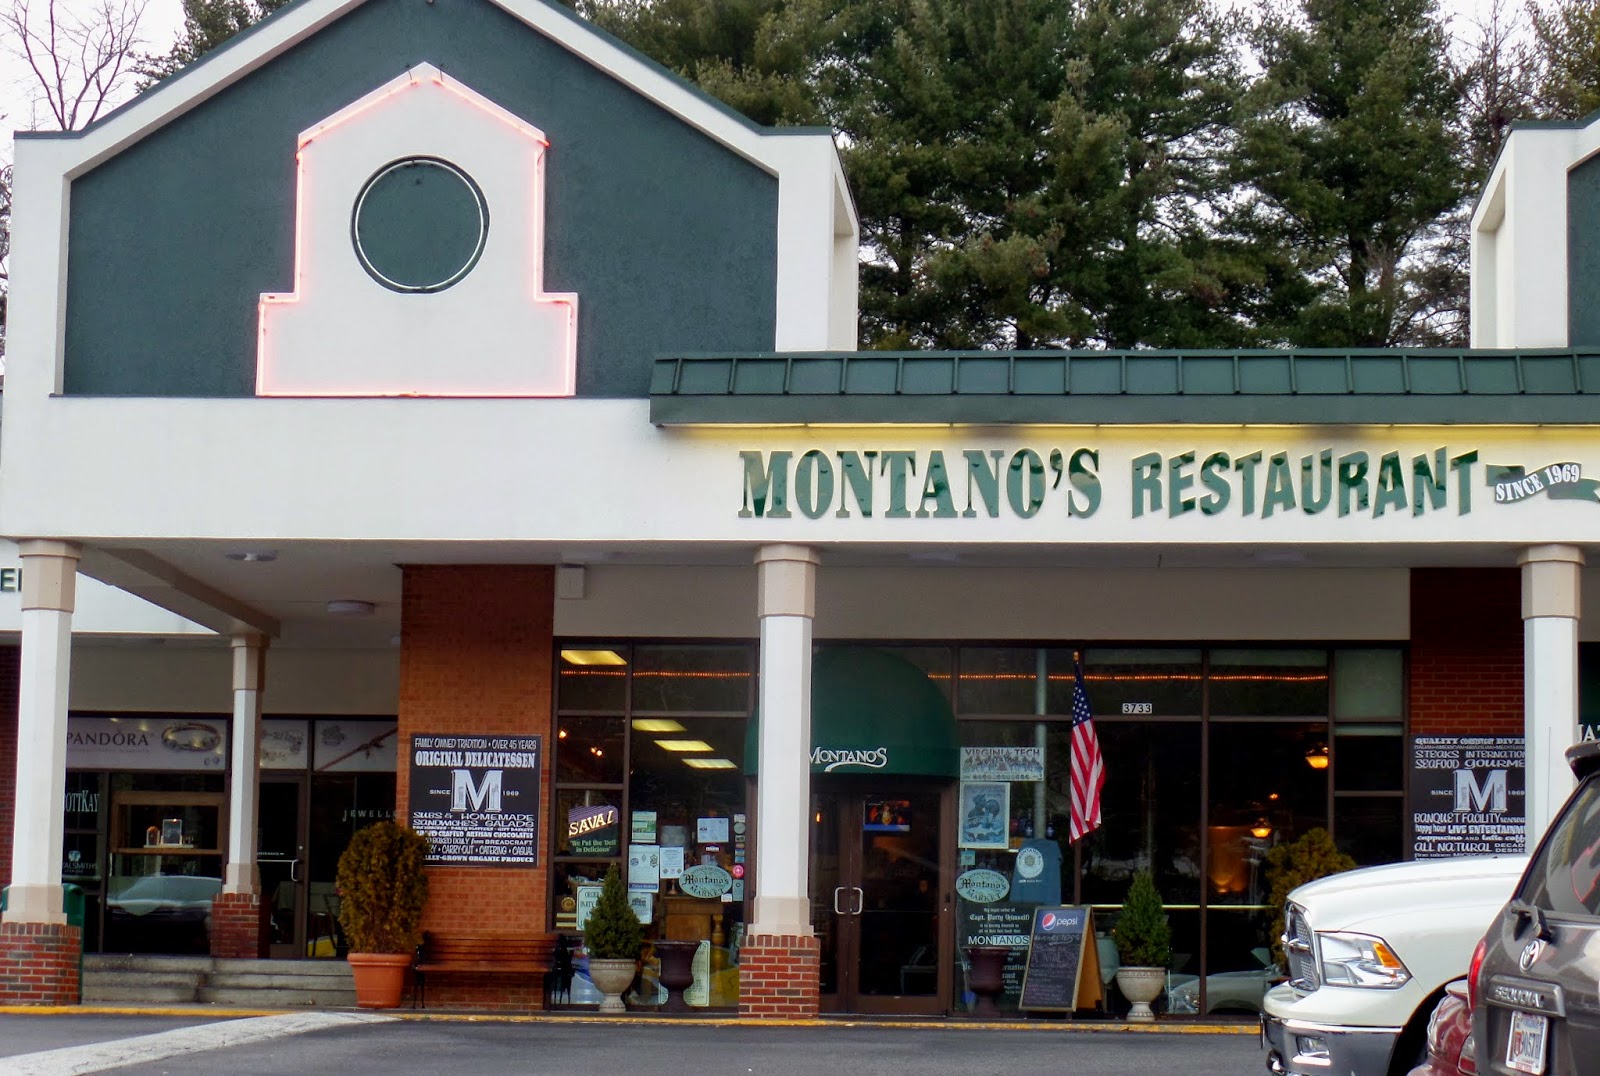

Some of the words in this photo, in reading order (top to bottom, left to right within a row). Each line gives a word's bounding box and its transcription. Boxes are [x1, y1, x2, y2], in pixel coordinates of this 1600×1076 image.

[738, 448, 1103, 519] MONTANO'S
[1131, 446, 1479, 519] RESTAURANT
[1495, 473, 1544, 501] SINCE
[1544, 464, 1580, 485] 1969
[1123, 703, 1151, 713] 3733
[66, 731, 149, 746] PANDORA
[457, 739, 487, 749] TRADITION
[491, 739, 508, 749] OVER
[518, 740, 537, 750] YEARS
[415, 751, 463, 767] ORIGINAL
[465, 752, 536, 768] DELICATESSEN
[450, 769, 503, 812] M
[1453, 769, 1508, 813] M
[460, 813, 534, 821] HOMEMADE
[569, 810, 614, 836] SAVAL
[485, 820, 534, 828] SALADS
[1448, 825, 1467, 833] LIVE
[1468, 825, 1525, 834] ENTERTAINM
[479, 845, 507, 855] CATERING
[512, 846, 534, 856] CASUAL
[681, 874, 729, 886] Montano's
[958, 878, 1007, 890] Montano's
[690, 885, 724, 897] MARKET
[967, 888, 1001, 901] MARKET
[1056, 917, 1078, 927] pepsi
[968, 935, 1029, 945] MONTANOS
[1494, 986, 1540, 1007] SEQUOIA
